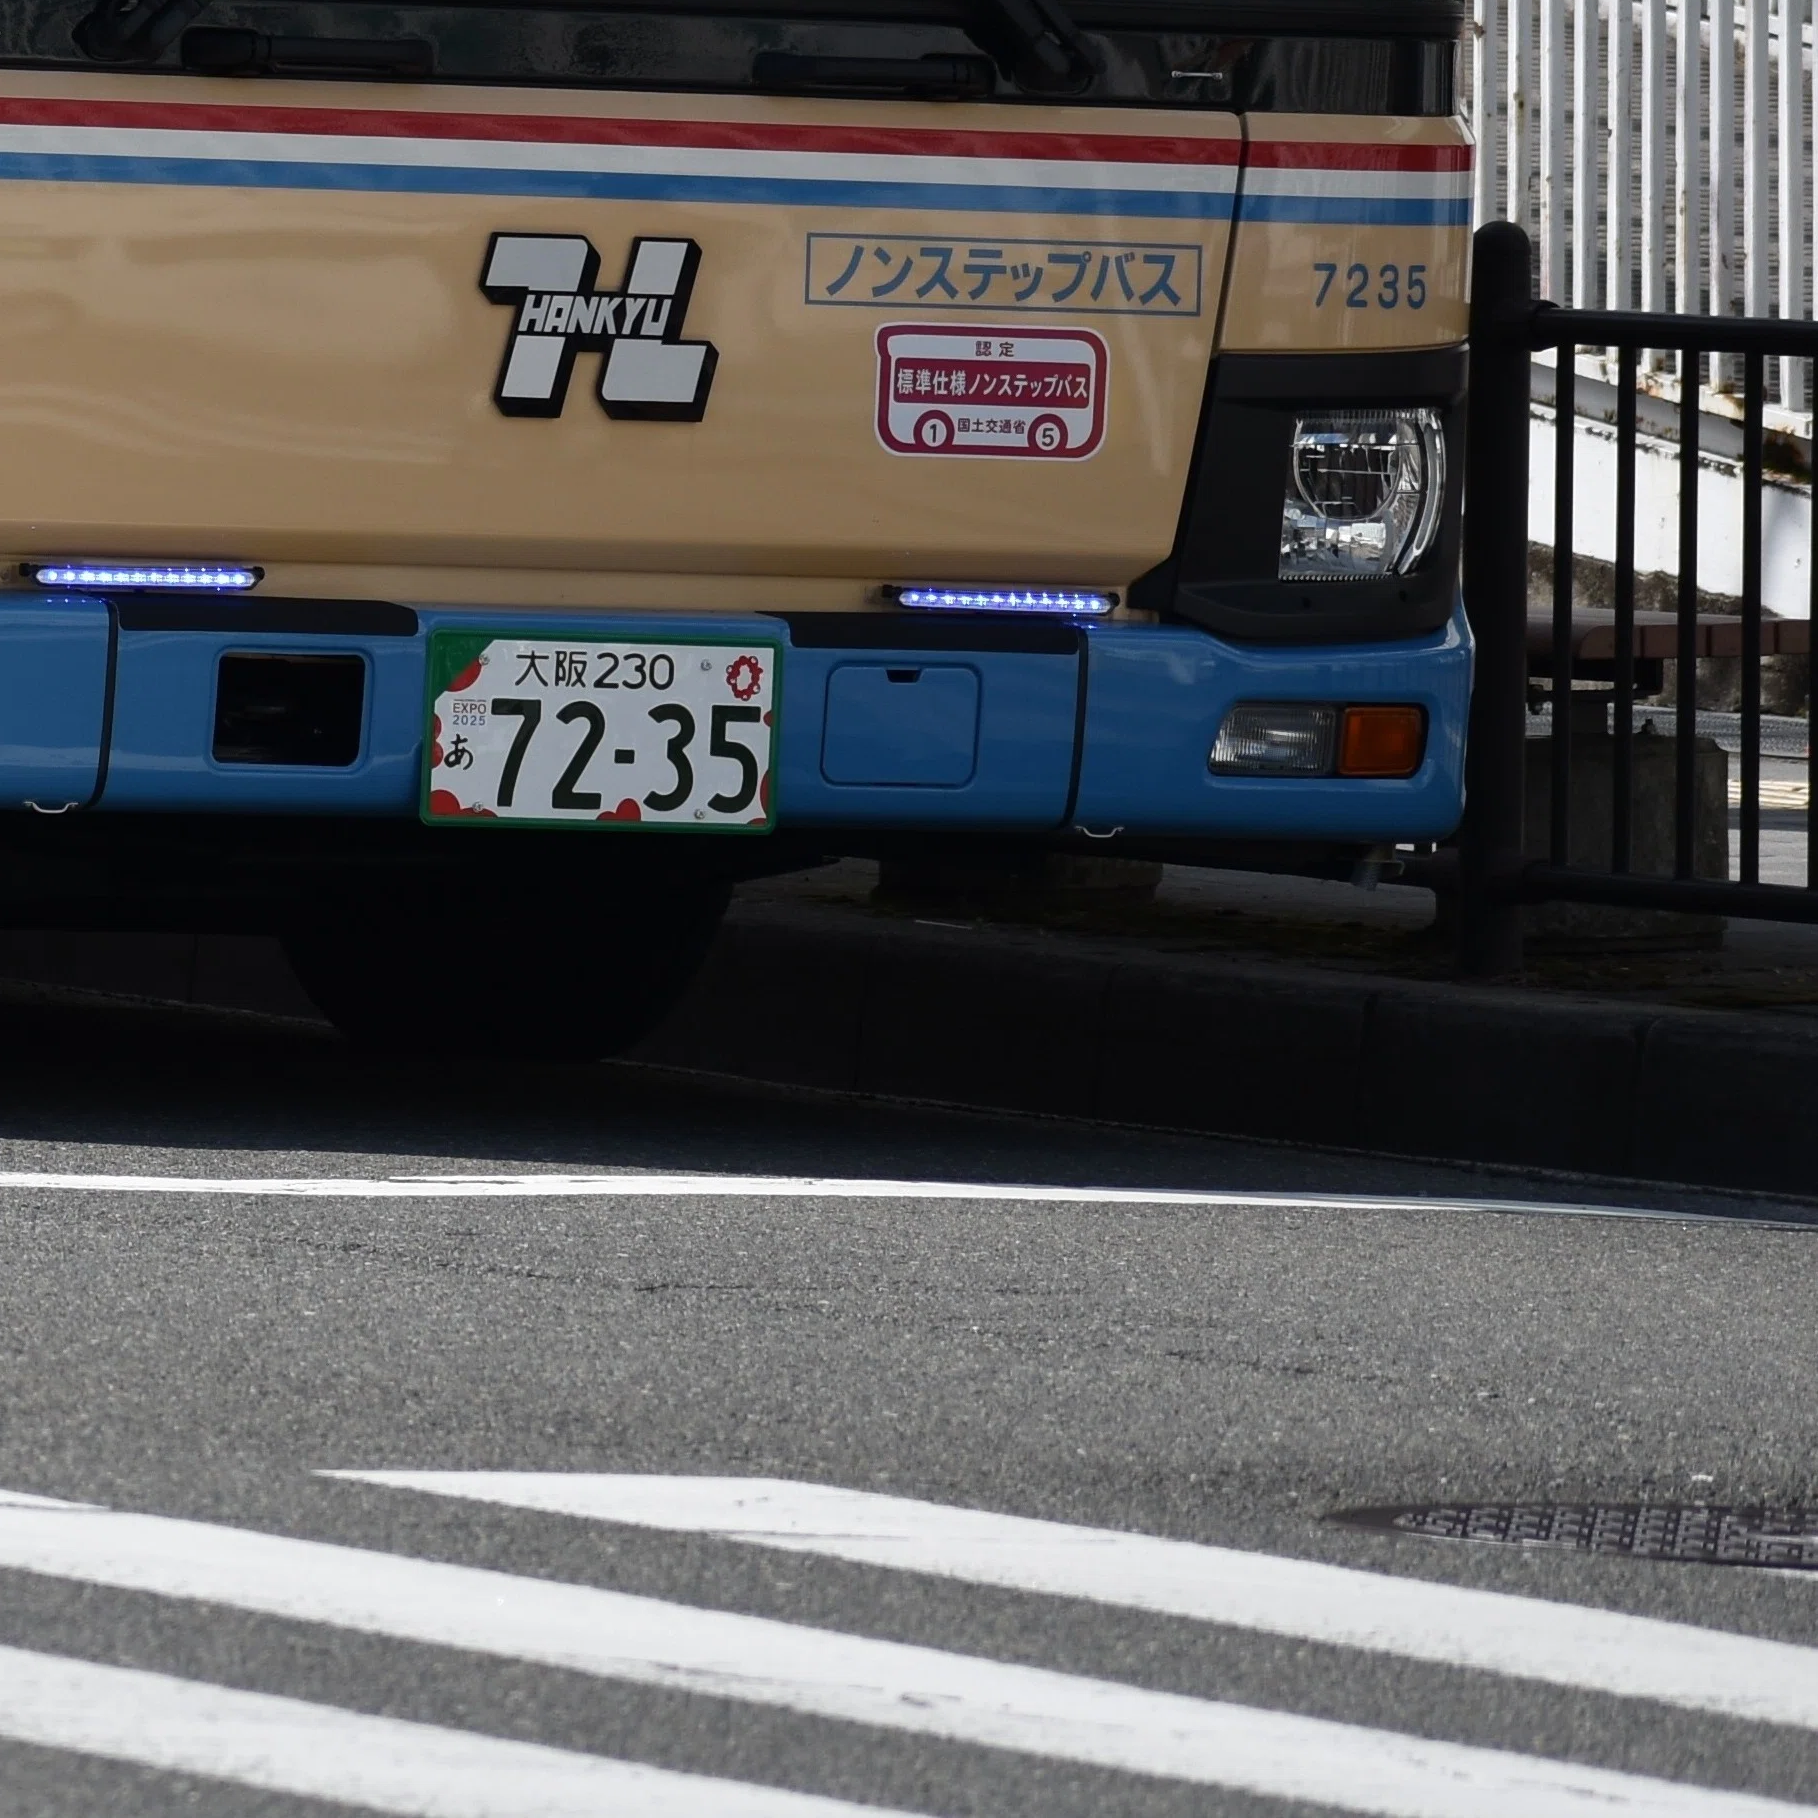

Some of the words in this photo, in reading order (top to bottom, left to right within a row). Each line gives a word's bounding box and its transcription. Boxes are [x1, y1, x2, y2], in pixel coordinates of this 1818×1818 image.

[824, 244, 1183, 308] ノンステップバス
[1313, 262, 1428, 311] 7235
[518, 294, 672, 337] HANKYU
[975, 340, 1015, 358] 認定
[897, 368, 1089, 399] 標準仕様ノンステップバス
[957, 418, 1027, 435] 国土交通省
[452, 702, 487, 714] EXPO
[452, 714, 486, 726] 2025
[444, 733, 474, 771] あ
[490, 697, 762, 814] 72-35
